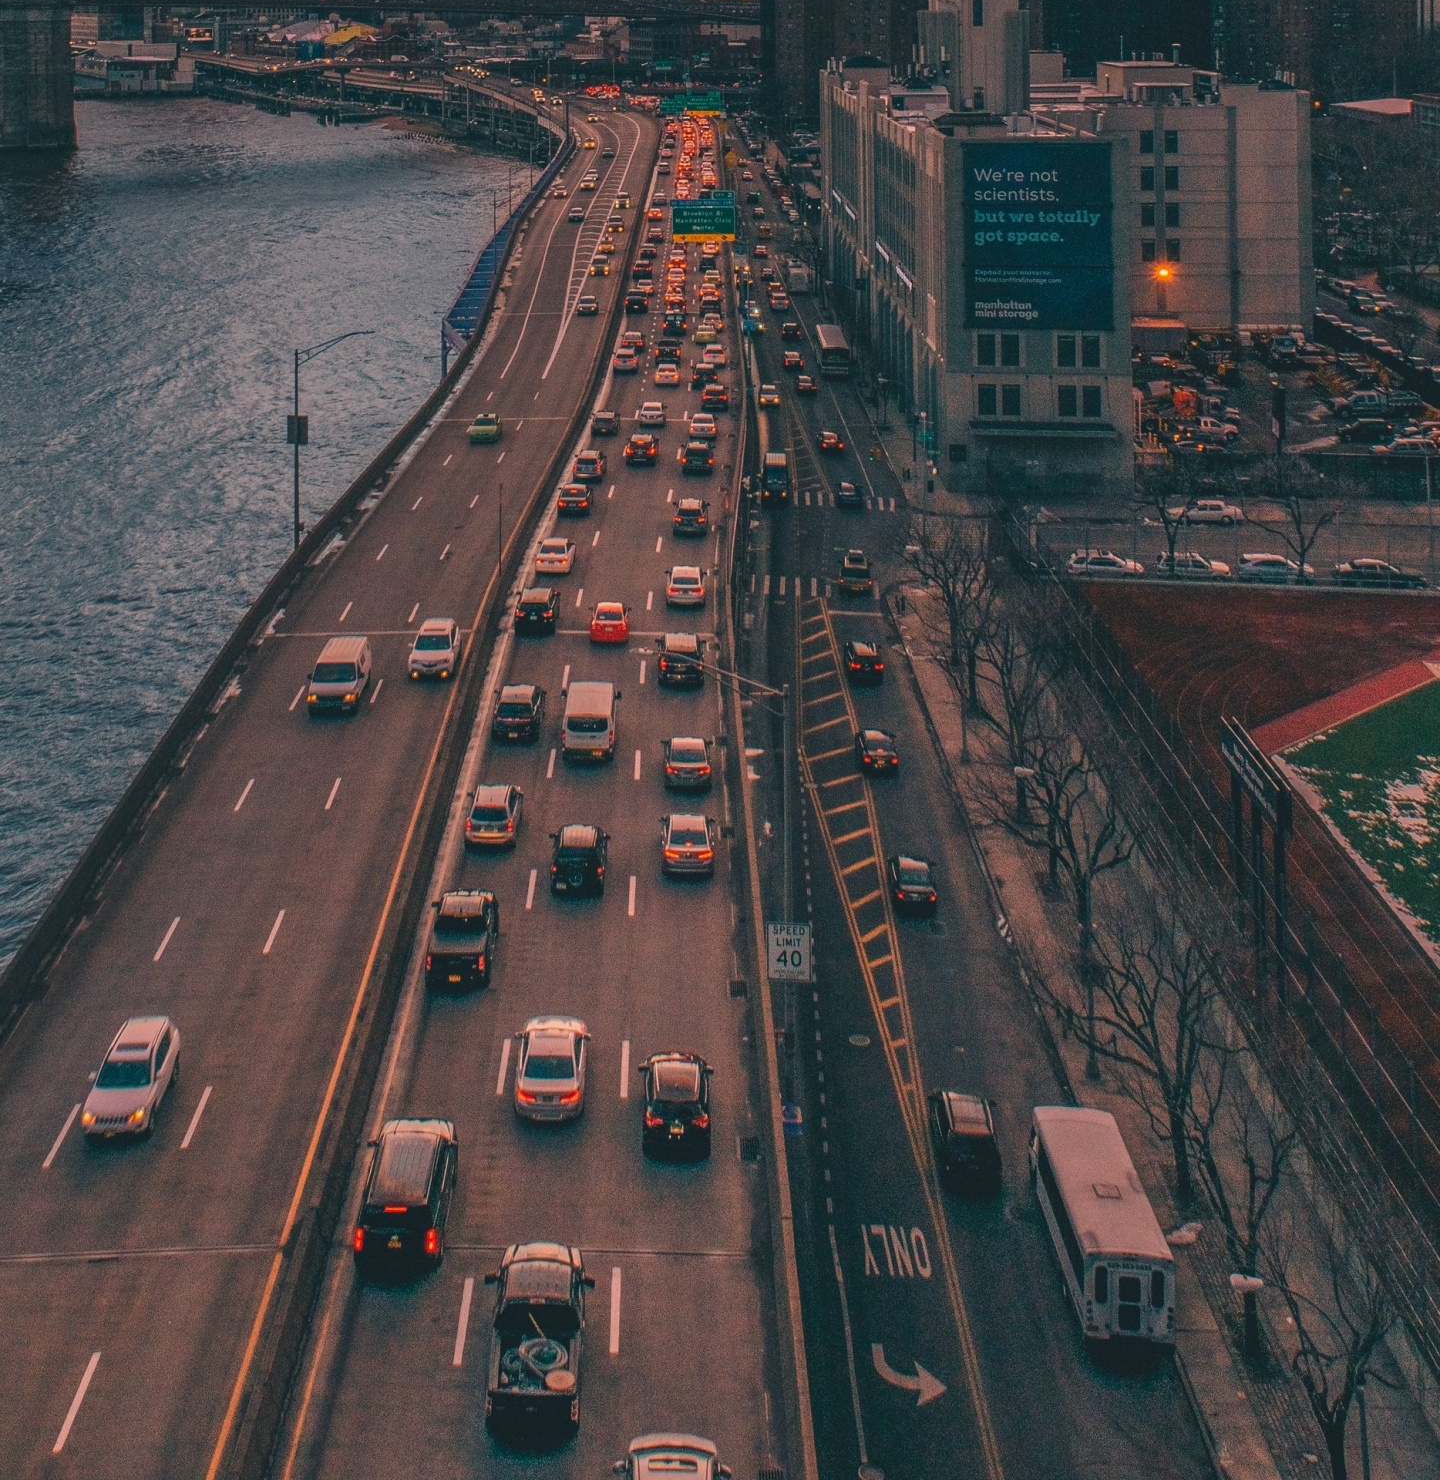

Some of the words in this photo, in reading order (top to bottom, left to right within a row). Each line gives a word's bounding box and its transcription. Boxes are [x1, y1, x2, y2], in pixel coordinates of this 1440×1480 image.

[974, 168, 1024, 182] We're
[1030, 169, 1058, 182] not
[974, 187, 1059, 202] scientists,
[974, 209, 1005, 223] but
[1008, 212, 1035, 223] we
[1038, 210, 1101, 227] totally
[974, 230, 1004, 246] got
[1007, 231, 1064, 246] space.
[975, 298, 1032, 310] manhattan
[975, 309, 997, 318] mini
[998, 309, 1039, 320] storage
[773, 925, 805, 935] SPEED
[776, 937, 802, 948] LIMIT
[776, 950, 802, 967] 40
[861, 1224, 932, 1280] ONLY
